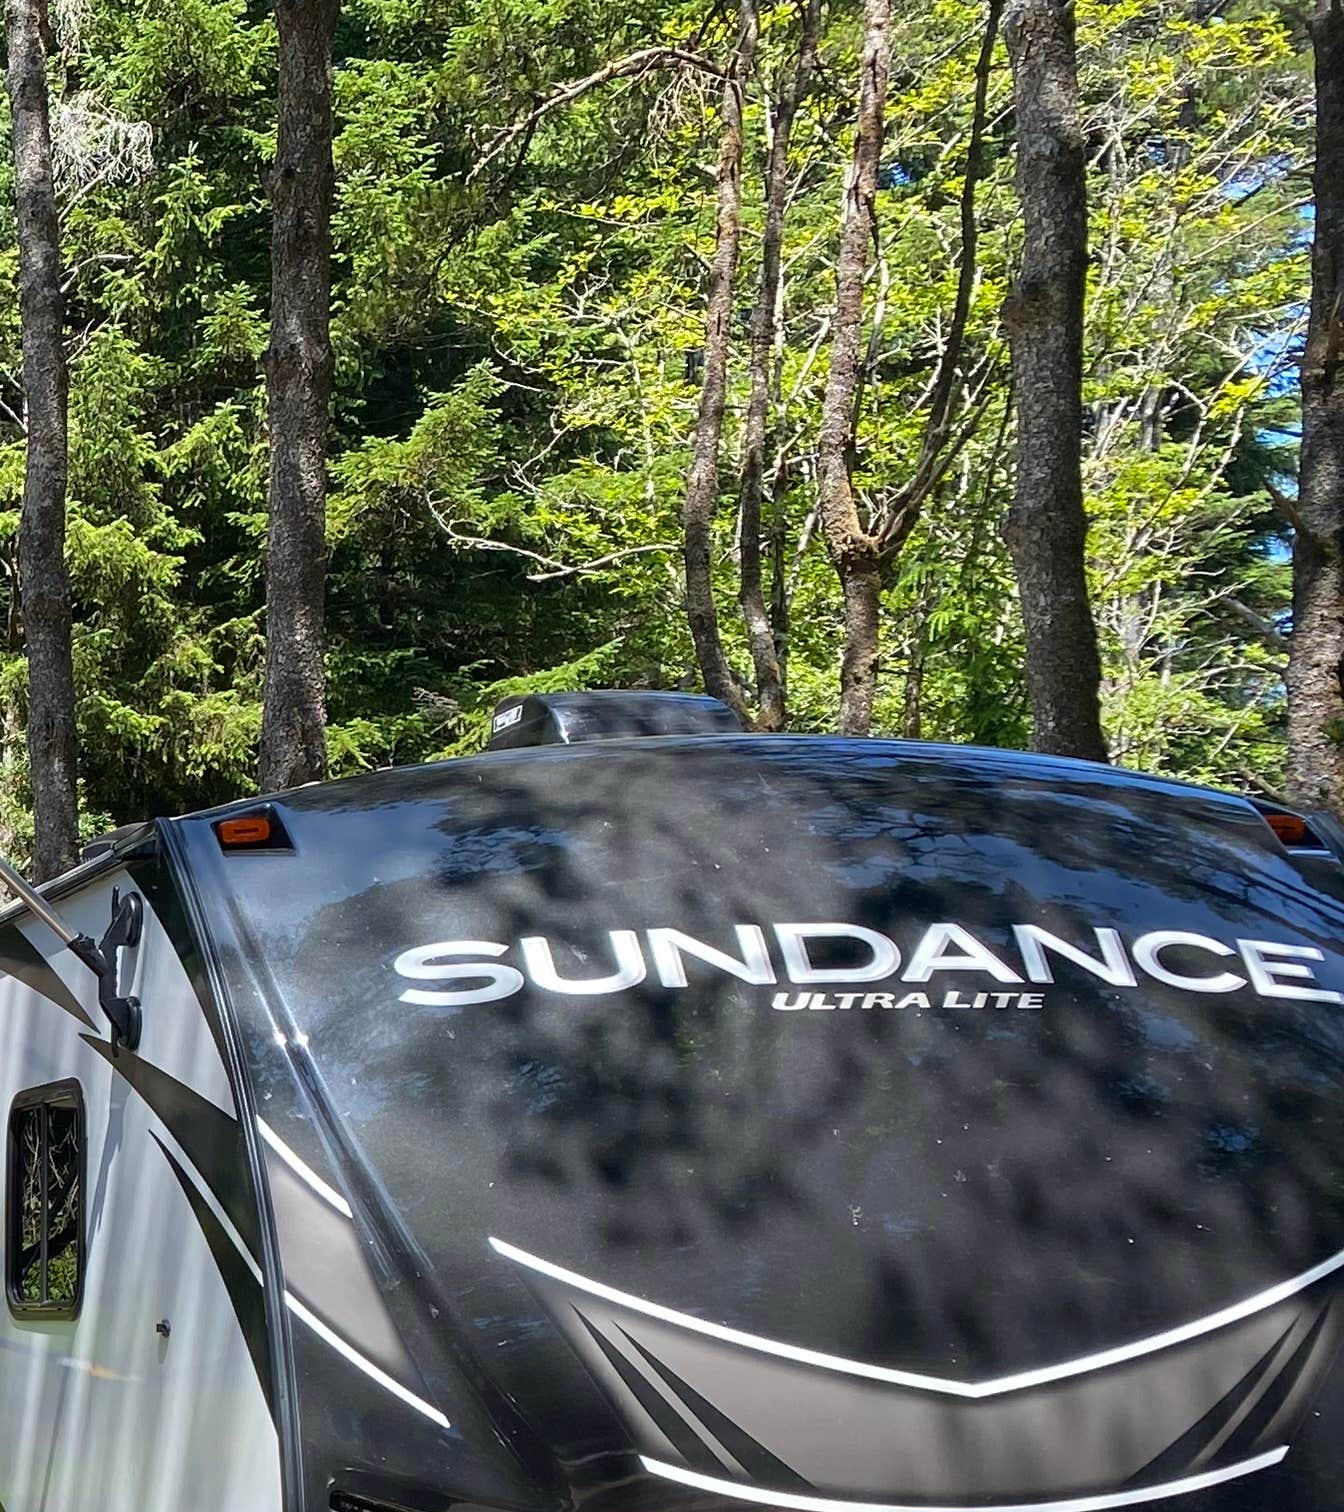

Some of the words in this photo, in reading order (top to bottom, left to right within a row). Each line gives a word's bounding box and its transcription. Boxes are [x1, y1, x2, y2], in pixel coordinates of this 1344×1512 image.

[394, 922, 1343, 1006] SUNDANCE
[771, 991, 931, 1011] ULTRA
[942, 990, 1047, 1010] LITE
